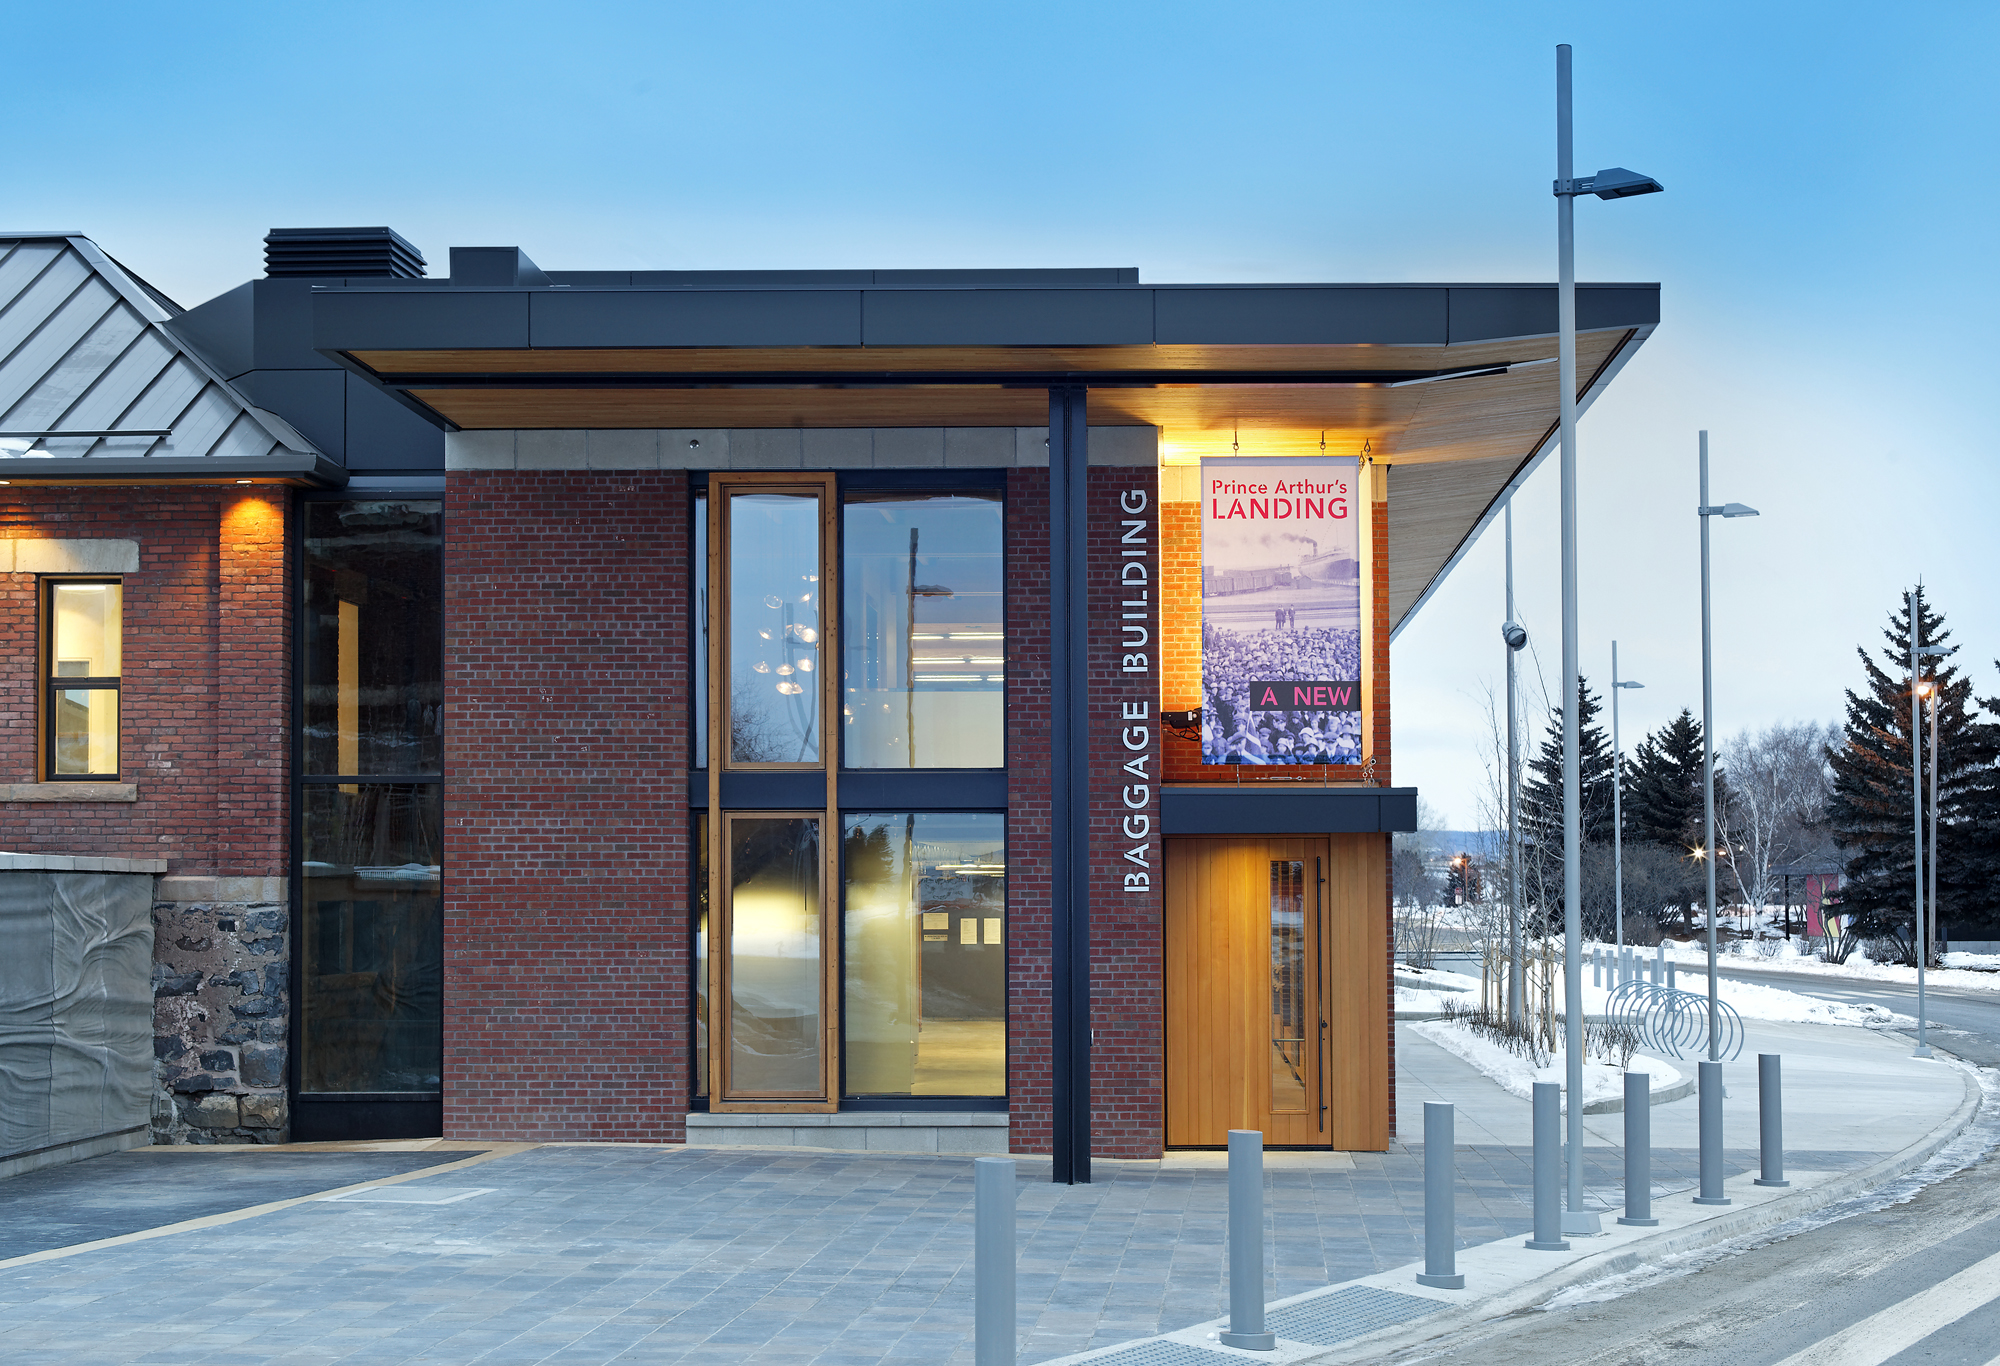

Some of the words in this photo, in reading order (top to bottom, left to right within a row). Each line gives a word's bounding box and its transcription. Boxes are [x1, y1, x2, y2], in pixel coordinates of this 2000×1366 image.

[1212, 479, 1268, 495] Prince
[1274, 479, 1348, 495] Arthur's
[1212, 497, 1348, 520] LANDING
[1120, 489, 1149, 673] BUILDING
[1260, 686, 1279, 706] A
[1293, 686, 1352, 706] NEW
[1122, 700, 1150, 892] BAGGAGE
